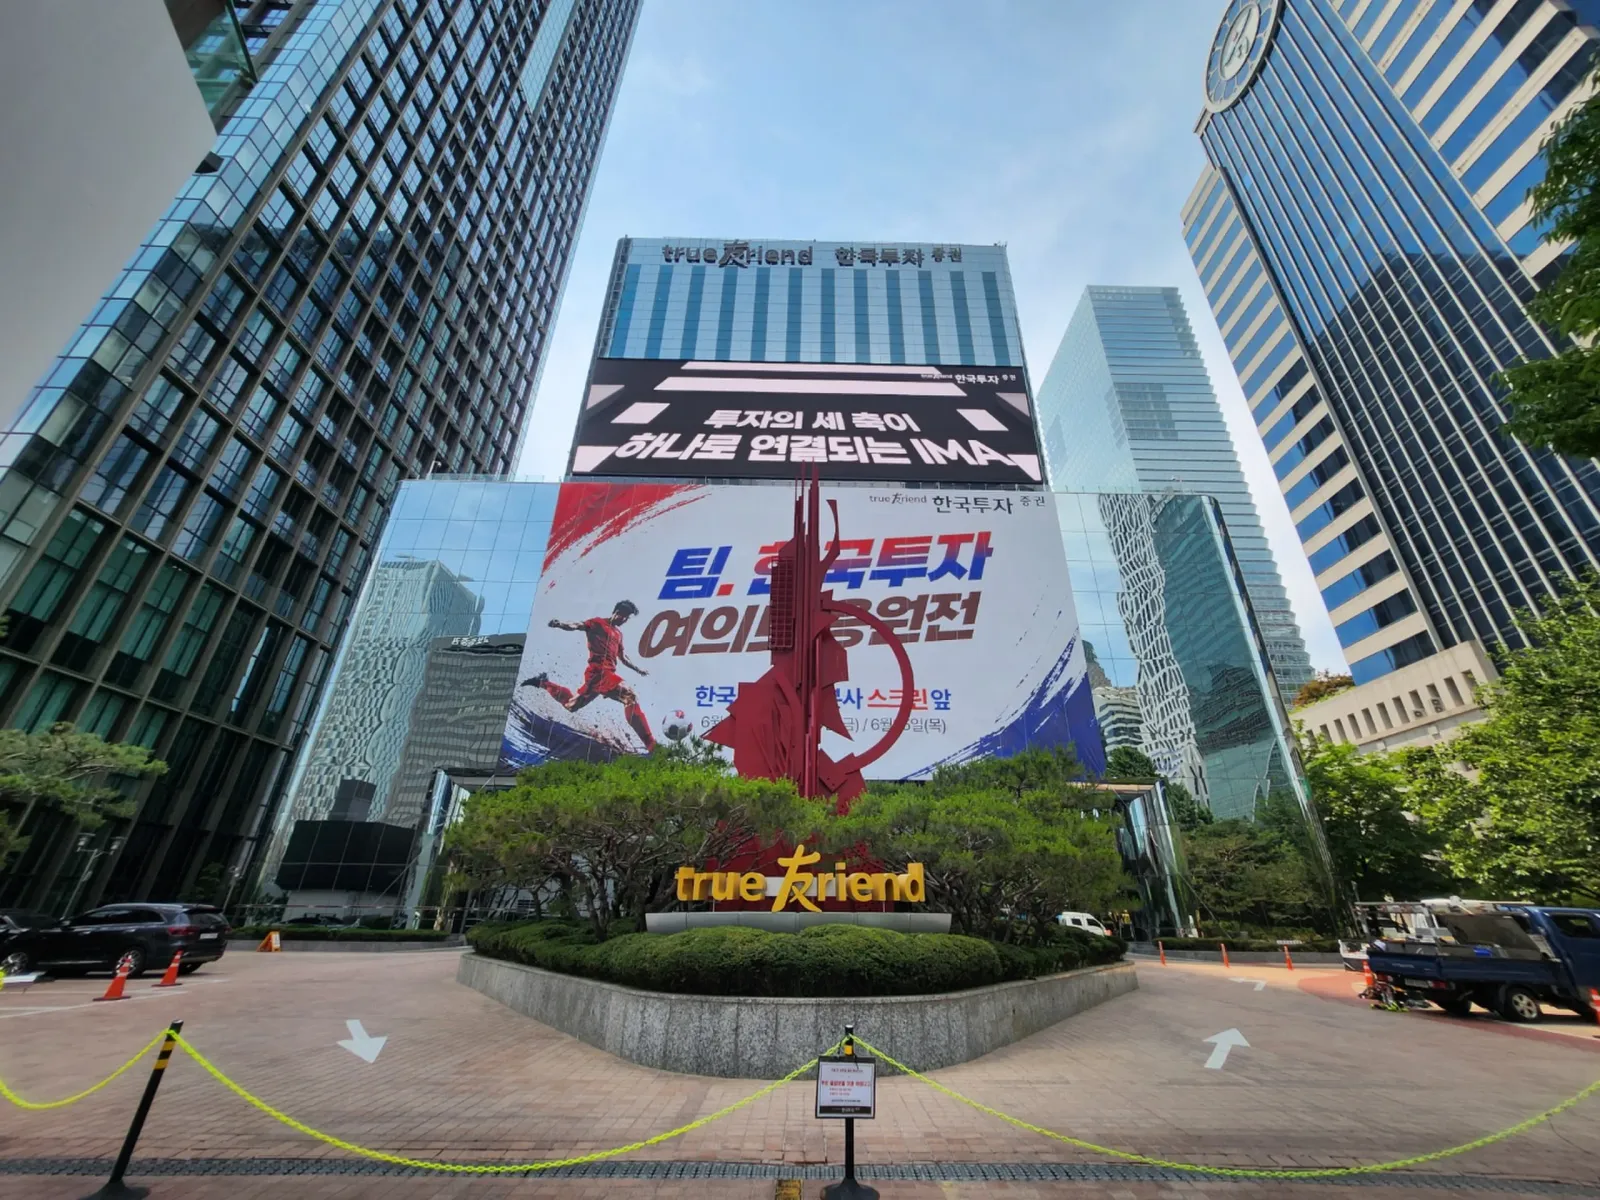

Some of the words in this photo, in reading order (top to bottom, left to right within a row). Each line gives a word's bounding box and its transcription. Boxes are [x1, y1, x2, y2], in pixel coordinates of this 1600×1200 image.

[834, 246, 924, 268] 한국투자
[954, 374, 1000, 385] 한국투자
[703, 409, 804, 430] 투자의
[811, 411, 847, 431] 세
[851, 411, 922, 433] 축이
[614, 432, 743, 461] 하나로
[747, 434, 912, 465] 연결되는
[909, 438, 1019, 467] IMA
[932, 495, 1014, 515] 한국투자
[1019, 495, 1047, 508] 증권
[657, 545, 733, 600] 팀.
[638, 604, 772, 659] 여의
